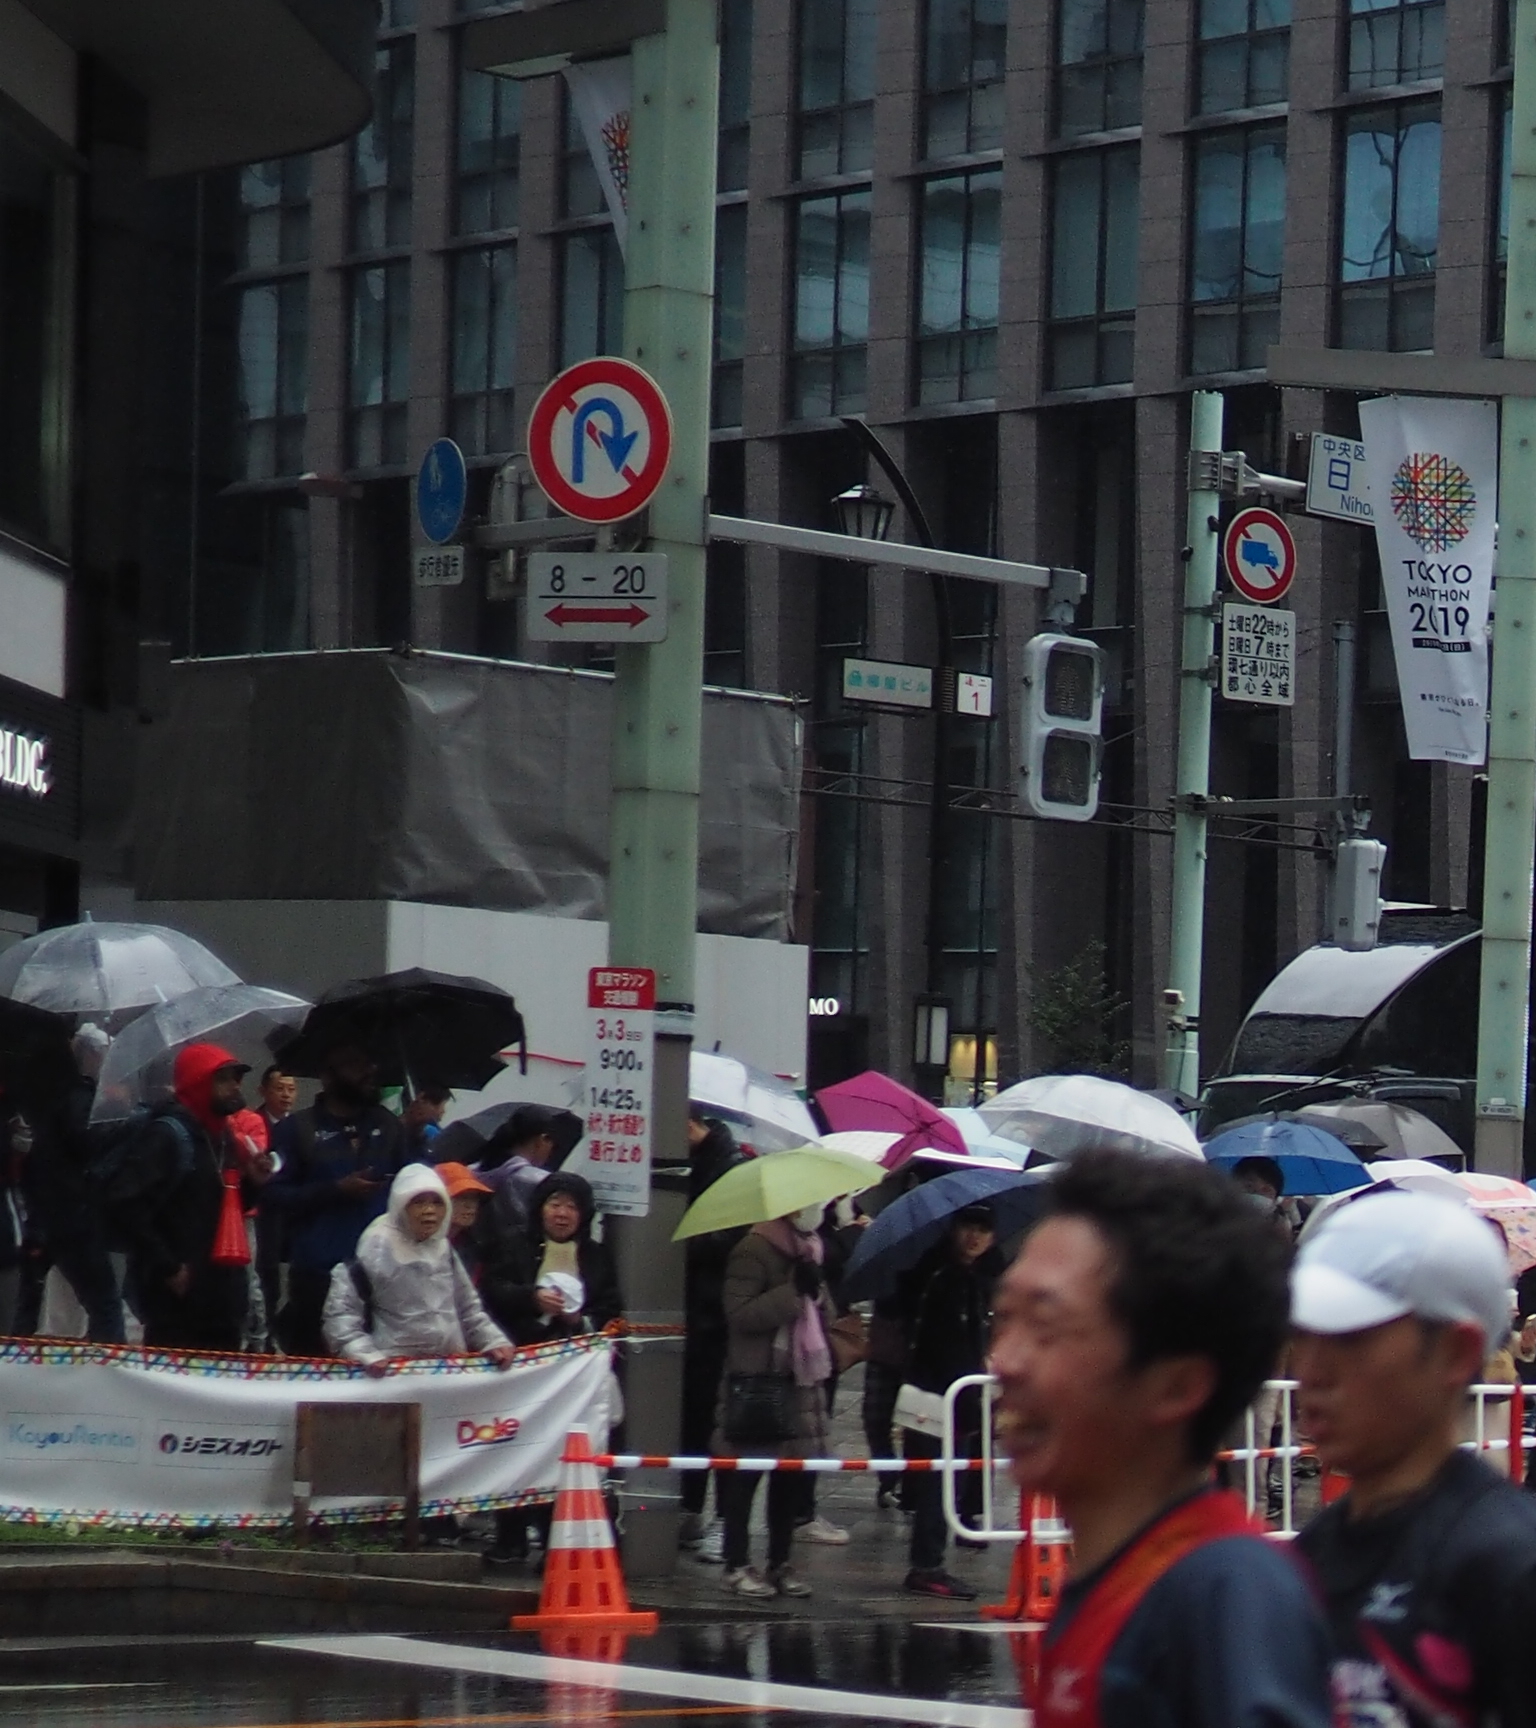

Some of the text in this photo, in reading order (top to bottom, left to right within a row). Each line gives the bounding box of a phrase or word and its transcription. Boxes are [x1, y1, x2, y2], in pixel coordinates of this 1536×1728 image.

[1323, 438, 1366, 461] 中央区
[550, 564, 565, 593] 8
[612, 565, 646, 594] 20
[457, 1416, 521, 1447] Dole
[181, 1436, 284, 1457] シミズオクト
